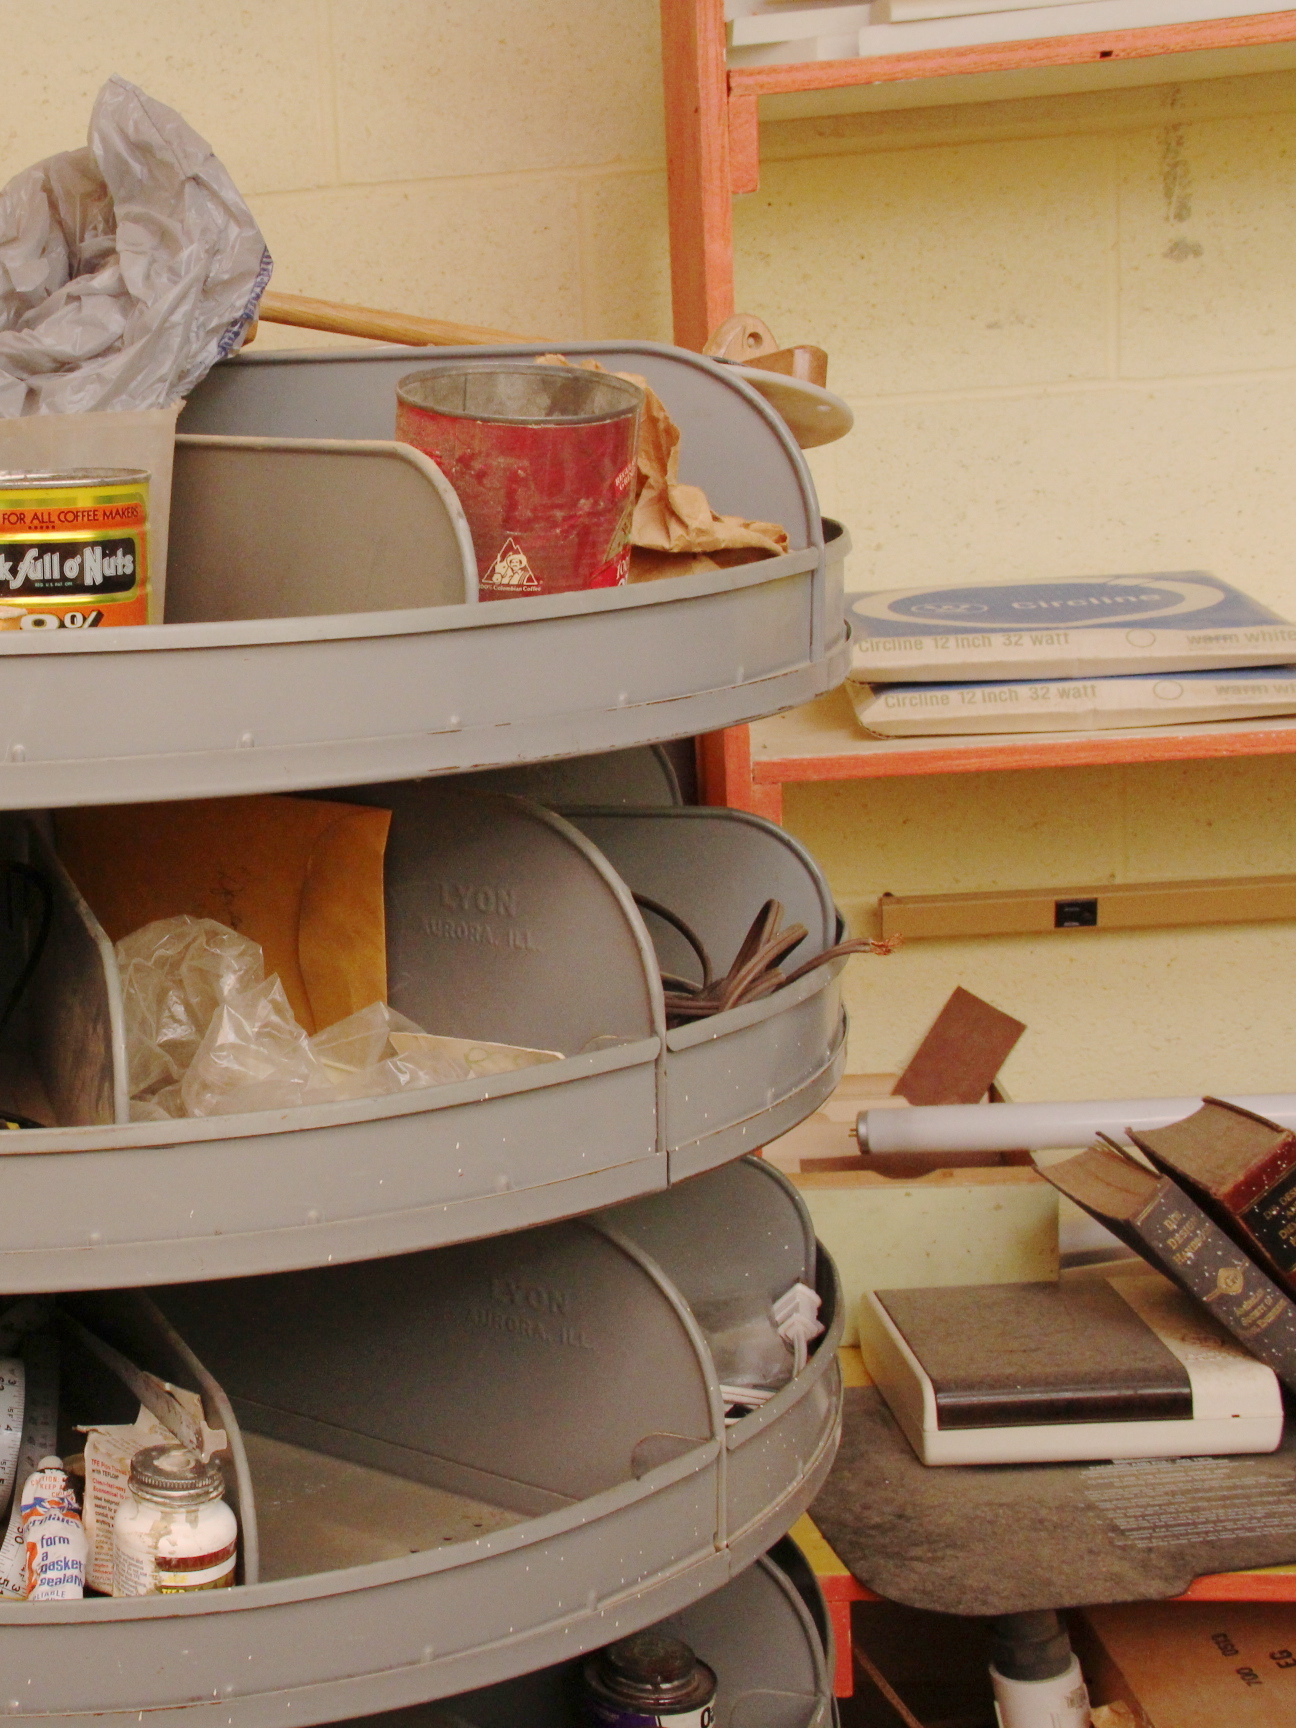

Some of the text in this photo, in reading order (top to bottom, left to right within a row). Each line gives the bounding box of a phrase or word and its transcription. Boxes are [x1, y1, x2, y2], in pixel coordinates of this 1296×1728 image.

[2, 512, 26, 525] FOR
[30, 511, 55, 524] ALL
[57, 509, 99, 523] COFFEE
[103, 506, 139, 520] MAKERS
[9, 548, 60, 589] full
[1011, 594, 1162, 611] Circline
[858, 637, 924, 653] Circline
[932, 635, 950, 649] 12
[955, 634, 993, 649] inch
[1003, 632, 1023, 647] 32
[1029, 631, 1070, 646] watt
[884, 692, 950, 708] Circline
[958, 690, 976, 705] 12
[981, 688, 1019, 704] inch
[1028, 685, 1051, 701] 32
[1057, 682, 1097, 700] watt
[438, 881, 518, 918] LYON
[41, 1534, 70, 1549] form
[40, 1556, 83, 1574] gasket
[41, 1551, 49, 1562] a
